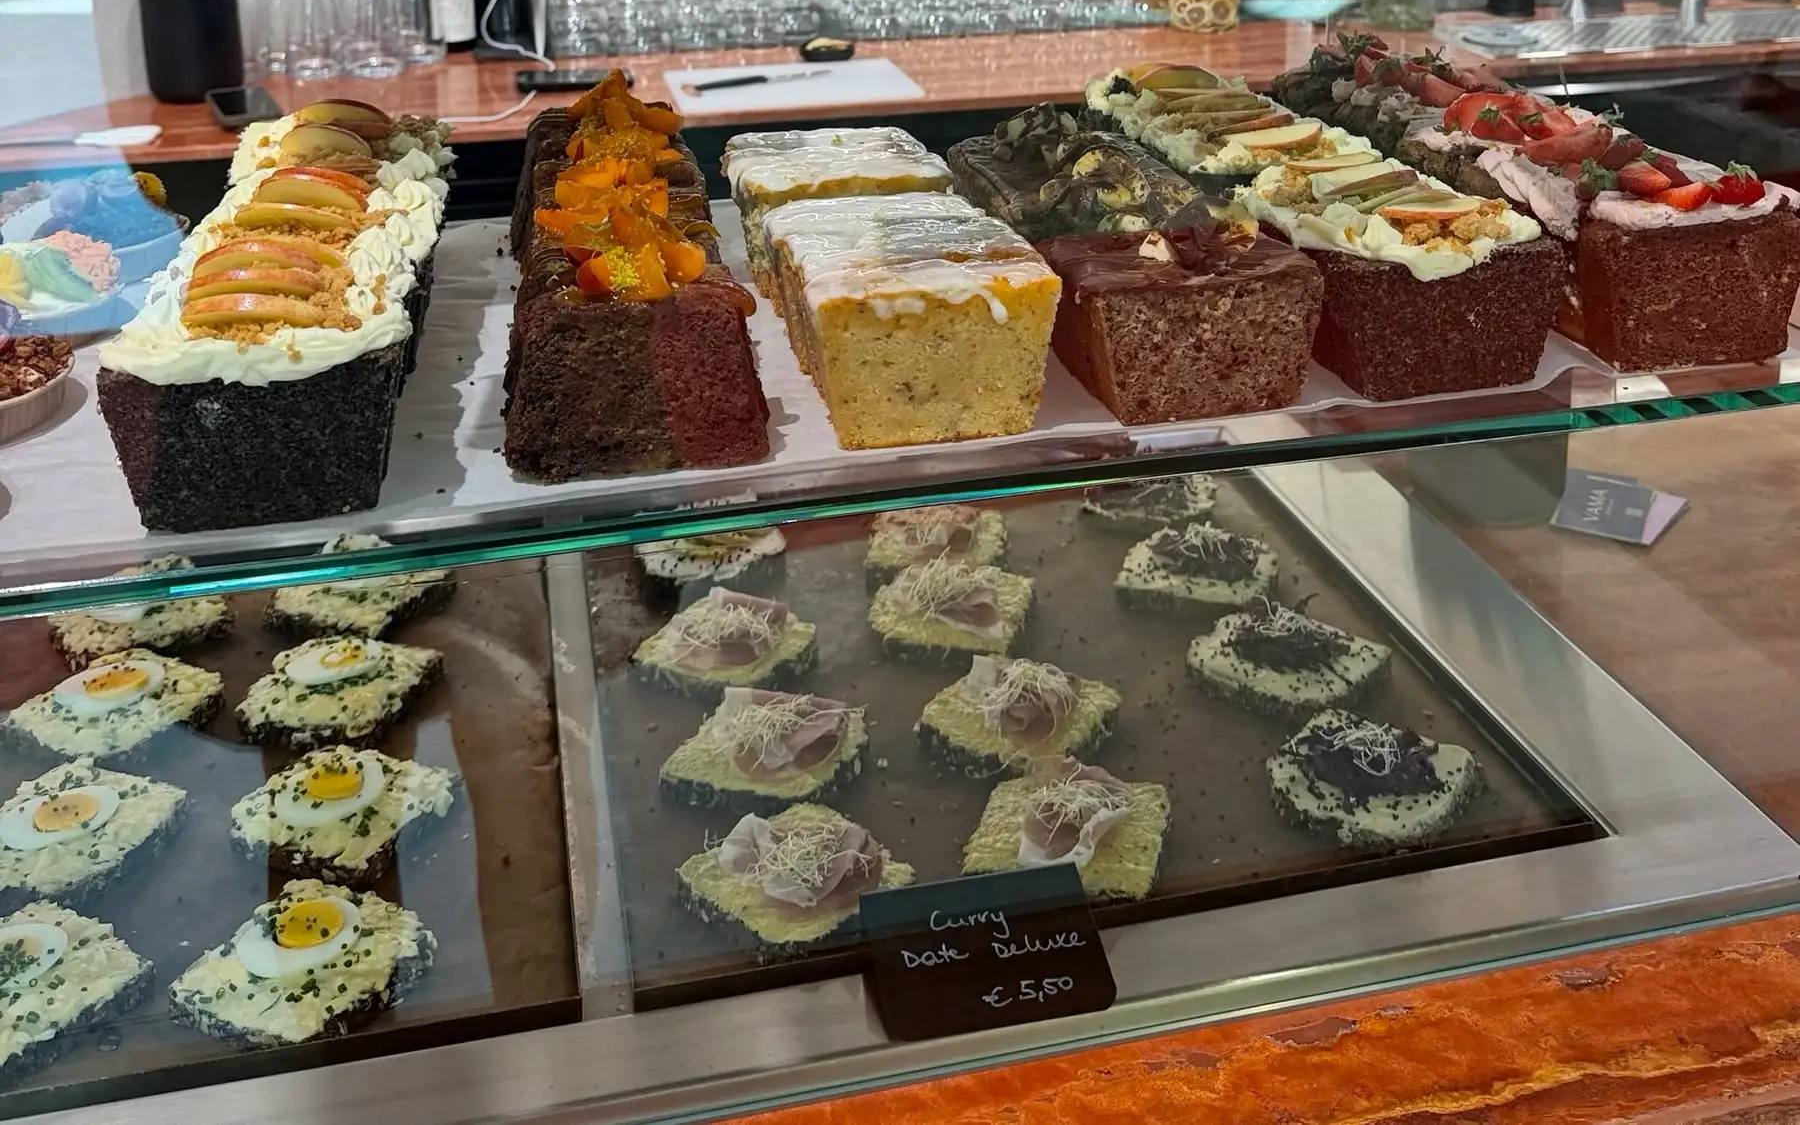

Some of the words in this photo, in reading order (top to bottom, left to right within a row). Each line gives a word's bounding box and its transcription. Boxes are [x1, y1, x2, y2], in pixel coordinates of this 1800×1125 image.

[929, 909, 1010, 939] Curry
[901, 943, 970, 969] Date
[991, 929, 1087, 959] Deluxe
[1019, 976, 1074, 1003] 5,50
